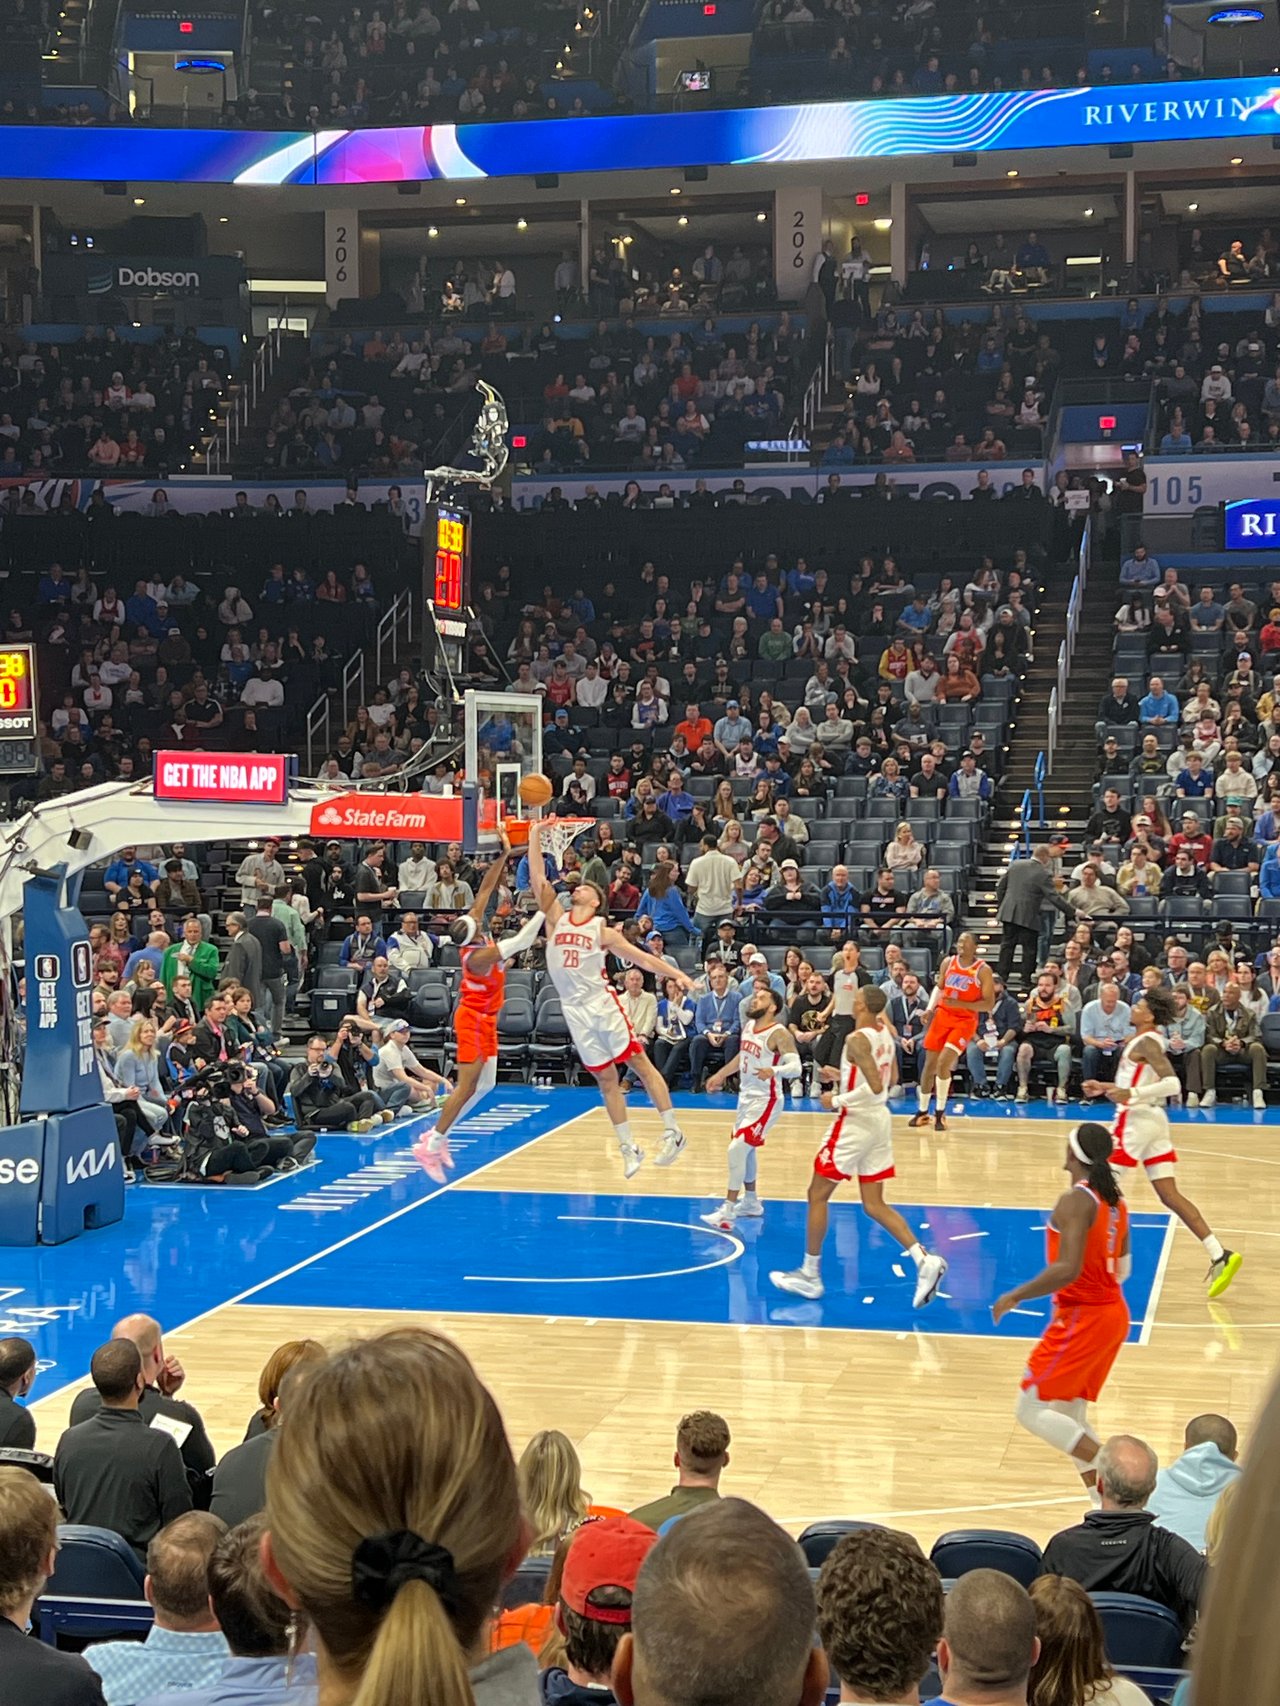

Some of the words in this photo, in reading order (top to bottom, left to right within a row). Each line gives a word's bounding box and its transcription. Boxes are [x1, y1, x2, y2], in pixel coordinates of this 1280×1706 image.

[793, 211, 804, 268] 206
[336, 227, 347, 282] 206
[118, 267, 199, 287] Dobson
[1150, 476, 1202, 506] 105
[1241, 513, 1277, 536] RI
[163, 762, 189, 786] GET
[190, 764, 217, 788] THE
[219, 765, 248, 790] NBA
[250, 766, 277, 791] APP
[563, 949, 579, 968] 28
[39, 981, 57, 997] GET
[39, 997, 58, 1013] THE
[38, 1013, 58, 1029] APP
[0, 1158, 39, 1184] se
